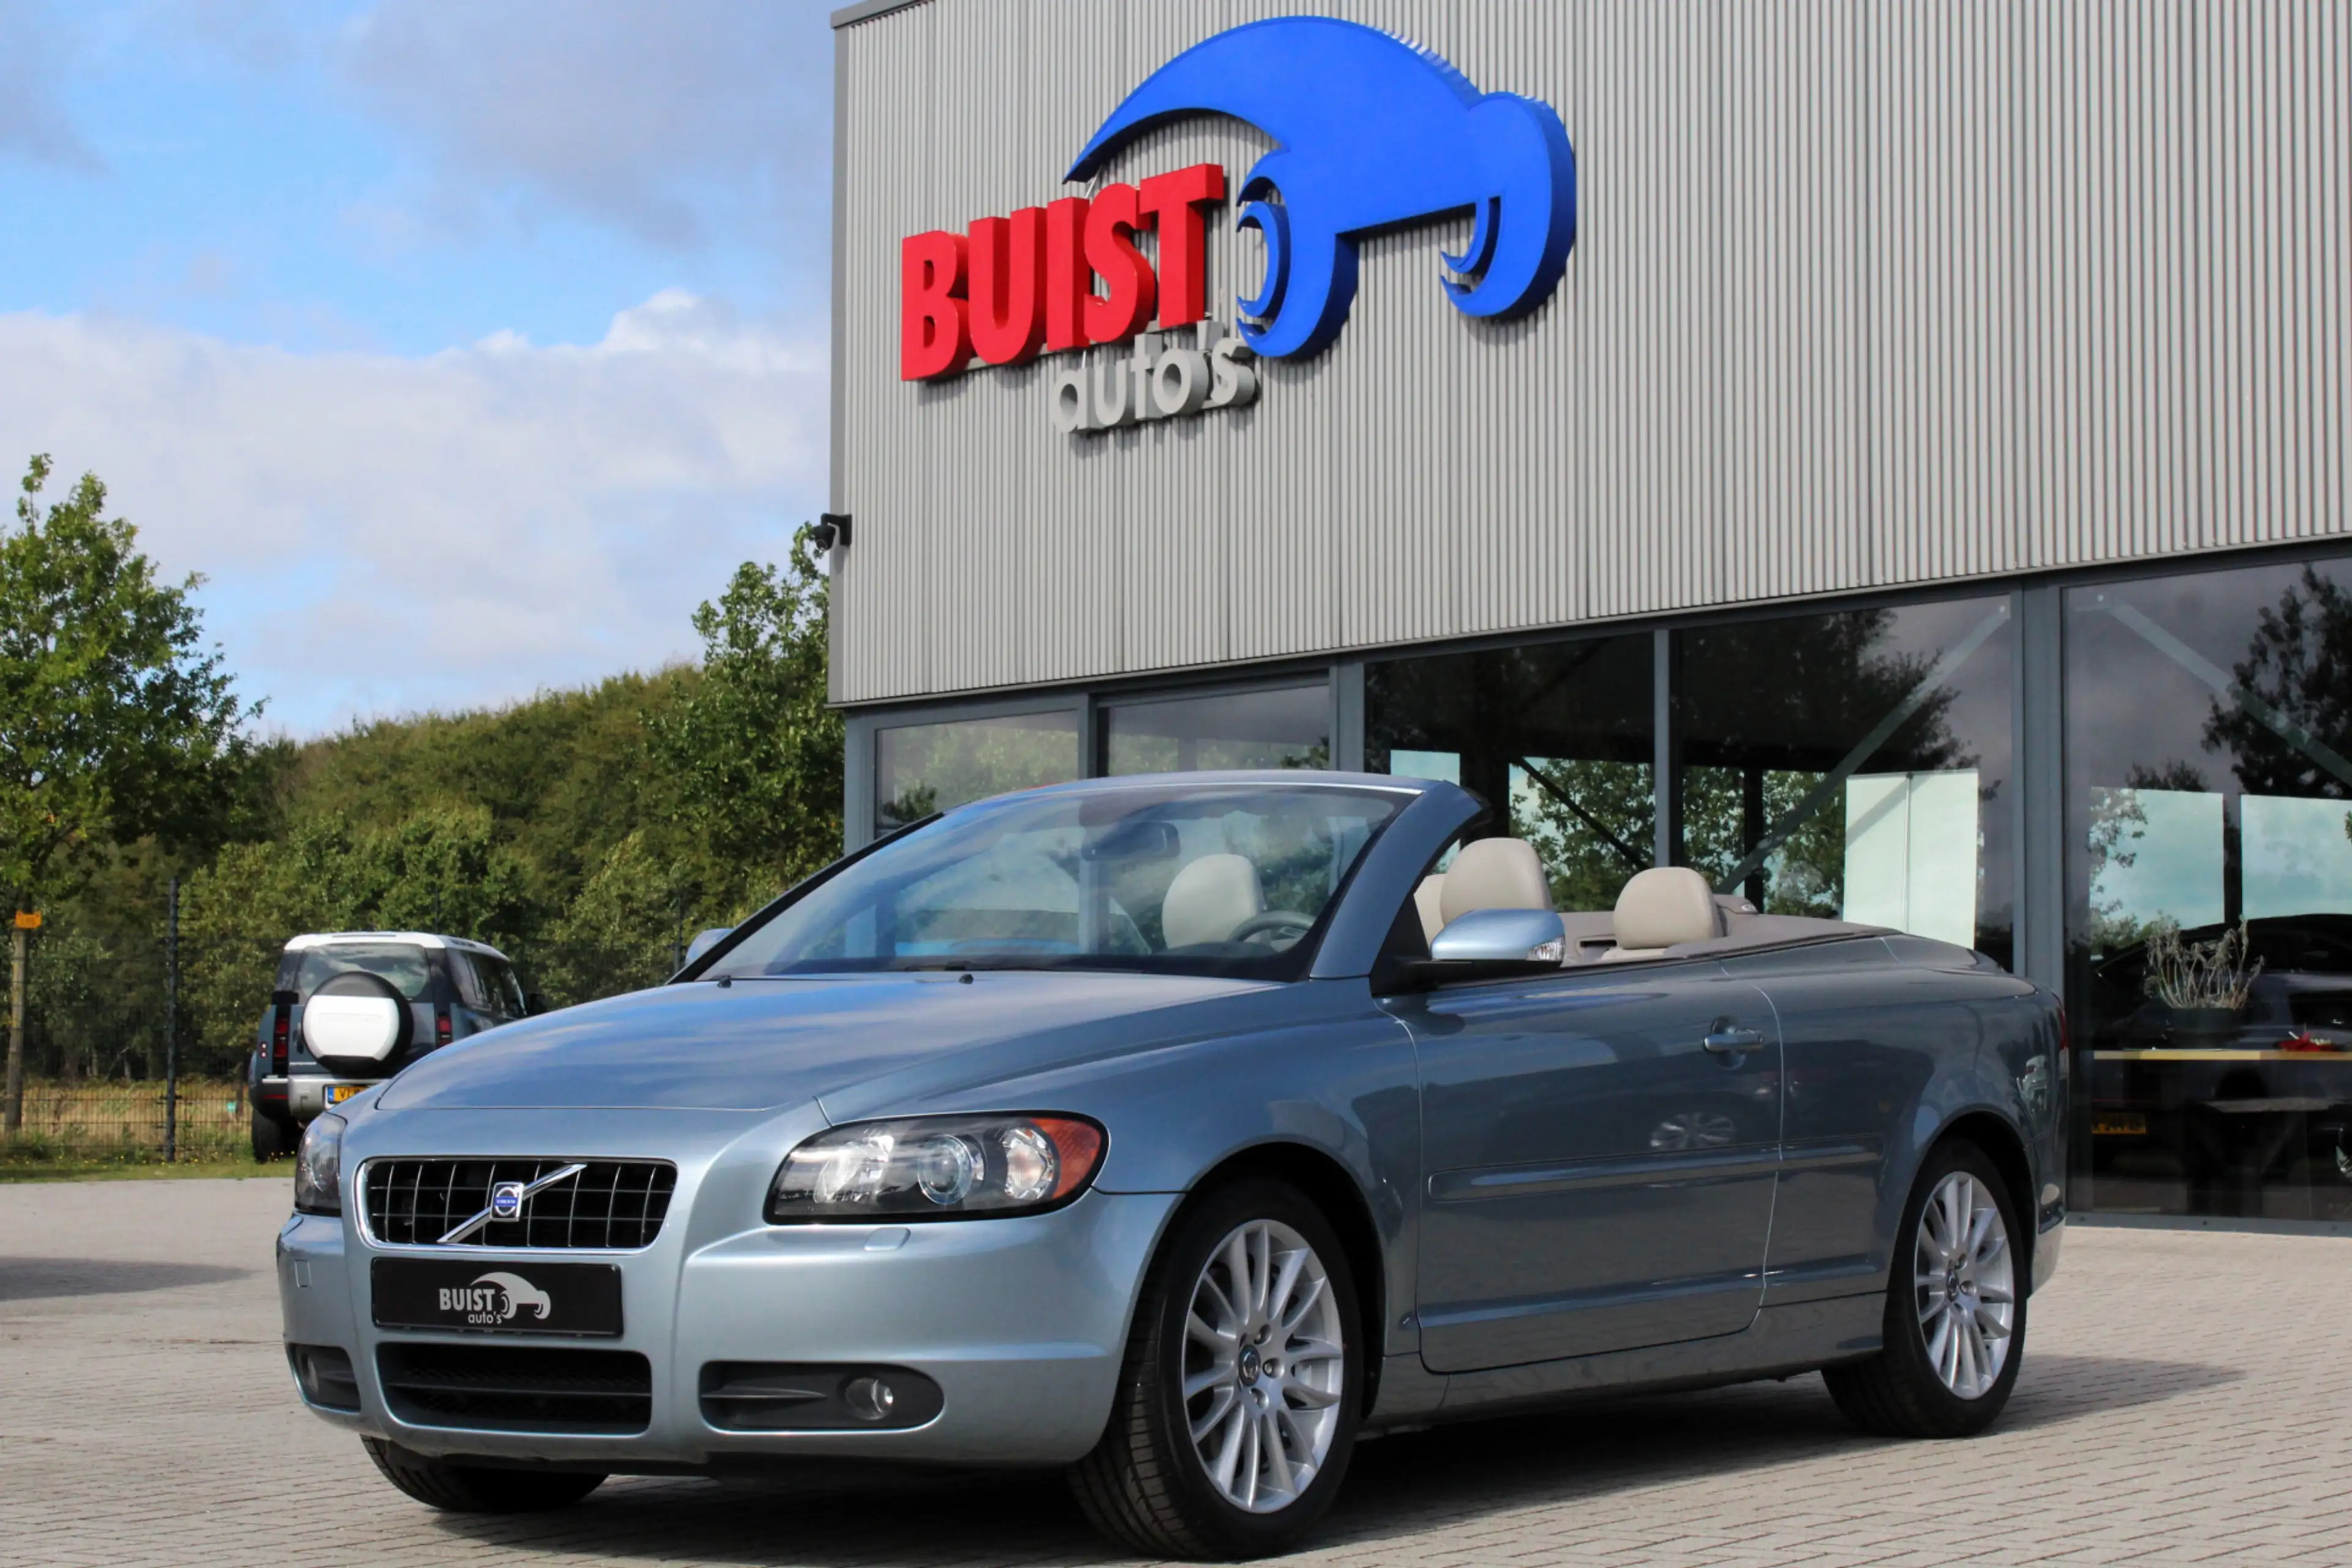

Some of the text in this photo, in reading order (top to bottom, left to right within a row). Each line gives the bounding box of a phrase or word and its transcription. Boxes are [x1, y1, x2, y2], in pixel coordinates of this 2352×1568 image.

[902, 163, 1224, 381] BUIST
[1053, 320, 1255, 432] auto's
[439, 1289, 495, 1311] BUIST
[468, 1311, 502, 1324] auto's
